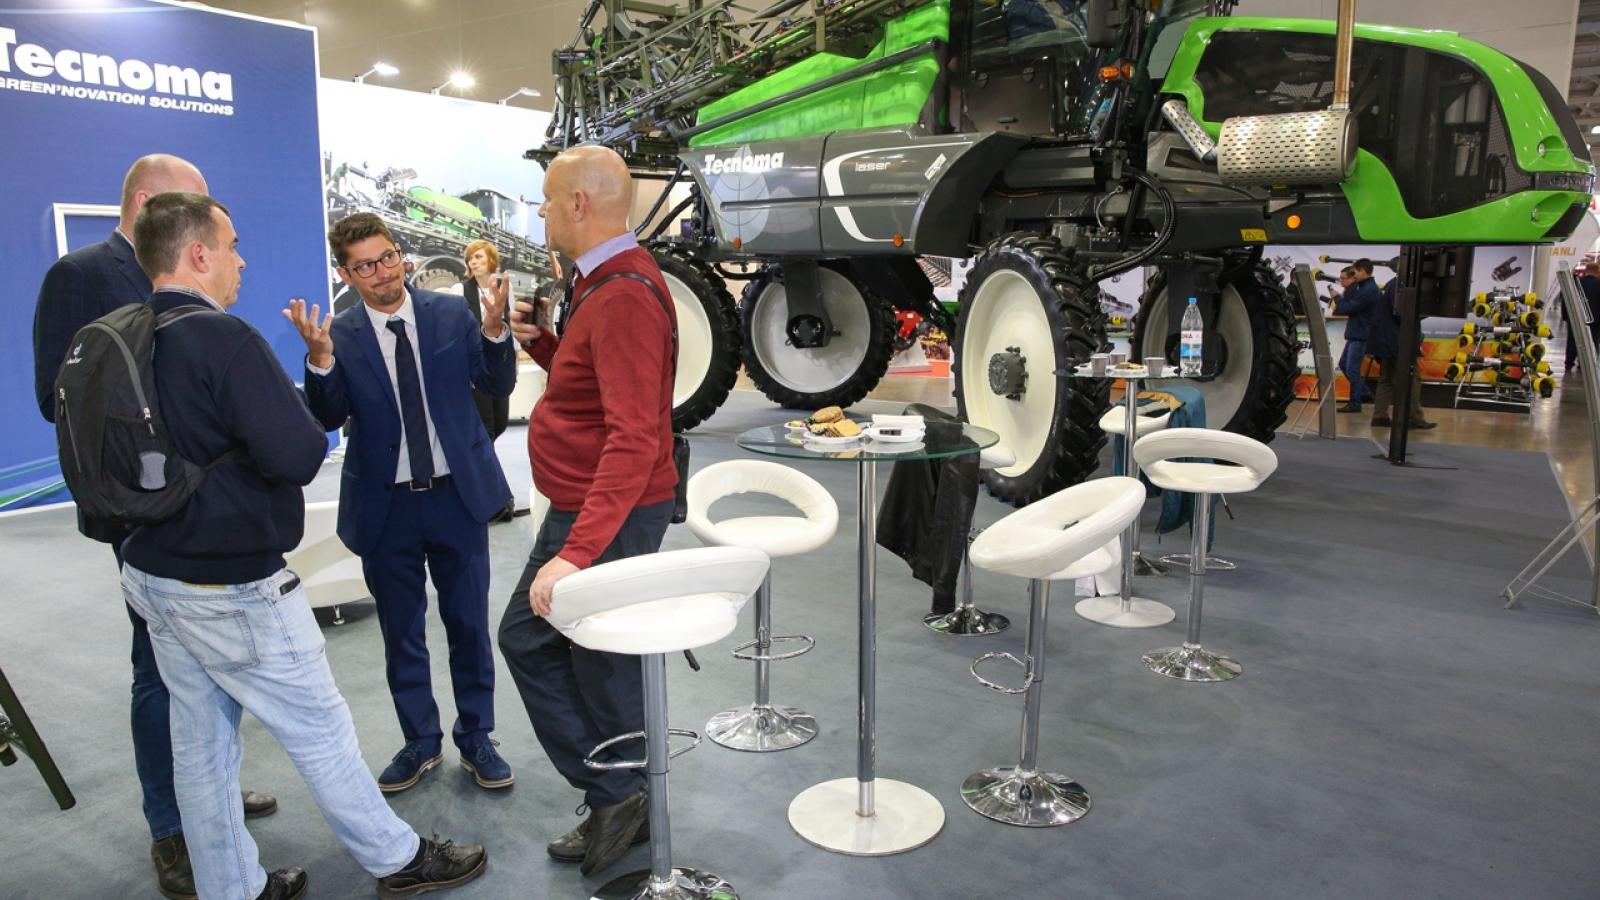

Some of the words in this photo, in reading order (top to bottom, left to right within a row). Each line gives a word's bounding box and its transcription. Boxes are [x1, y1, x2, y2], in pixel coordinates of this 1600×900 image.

[149, 96, 234, 115] SOLUTIONS
[704, 152, 784, 175] Tecnoma
[855, 161, 892, 173] laser
